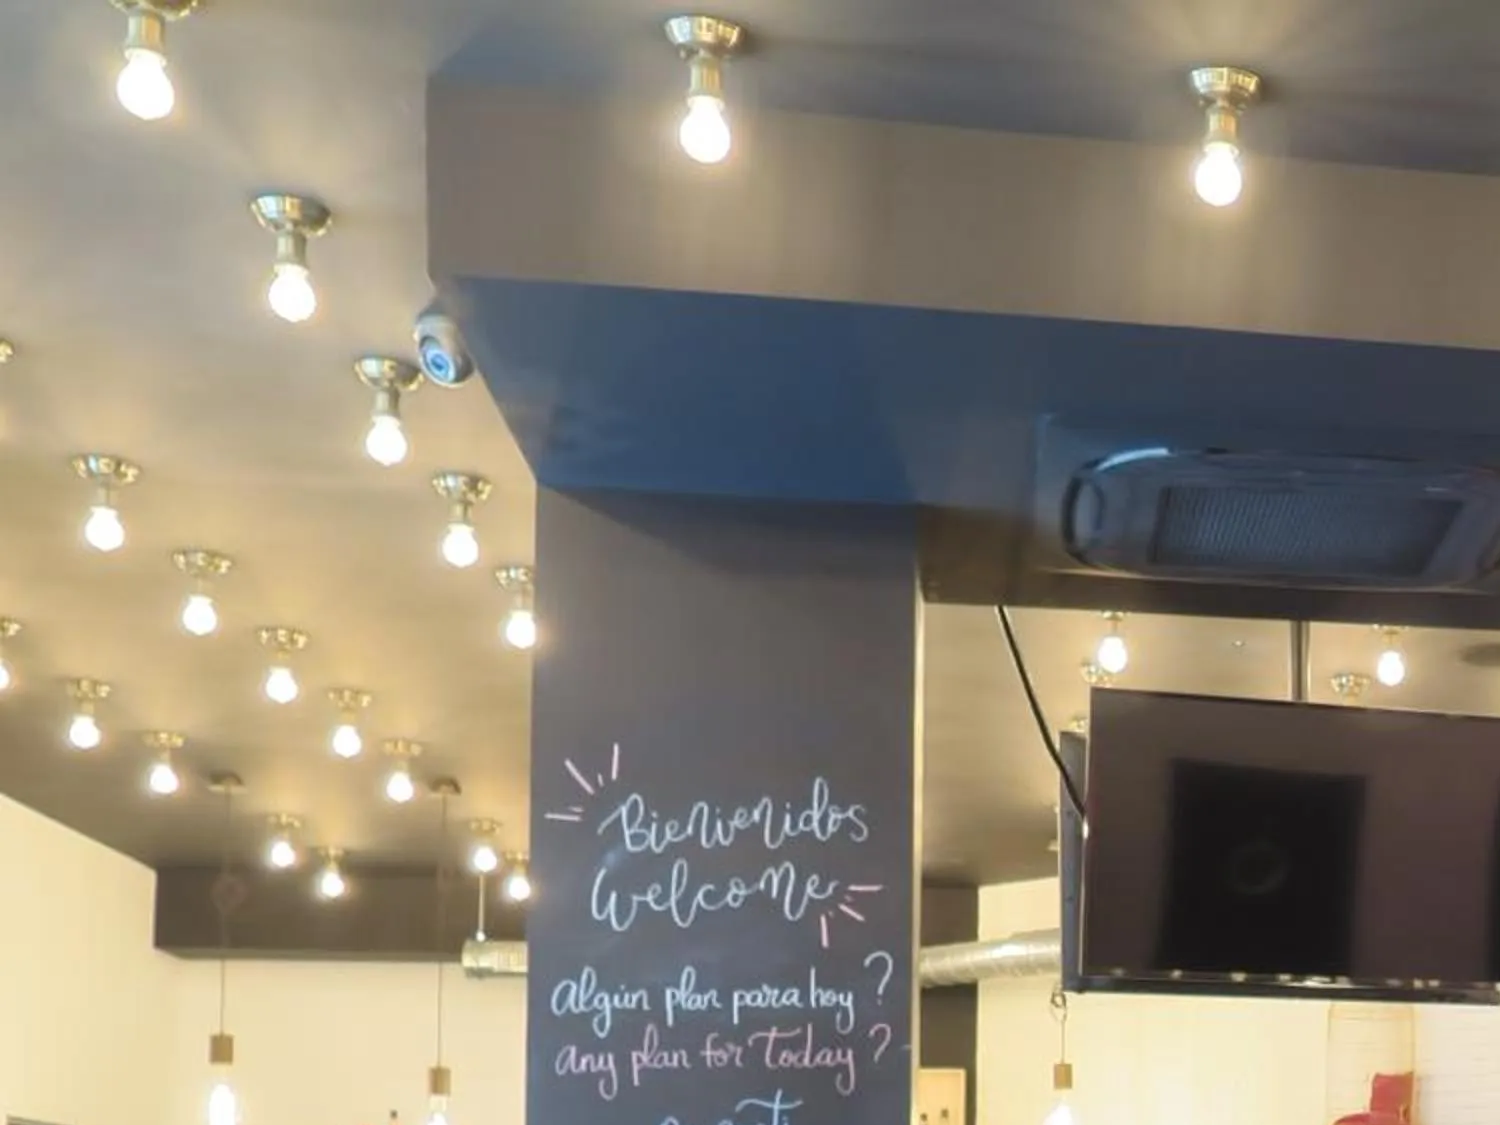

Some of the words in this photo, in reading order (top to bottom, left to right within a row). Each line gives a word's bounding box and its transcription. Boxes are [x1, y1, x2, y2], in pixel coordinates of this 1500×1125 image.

[597, 776, 869, 853] Bienvenidos
[665, 965, 722, 1028] plan
[733, 984, 803, 1024] para
[631, 1023, 692, 1086] plan
[700, 1032, 743, 1068] for
